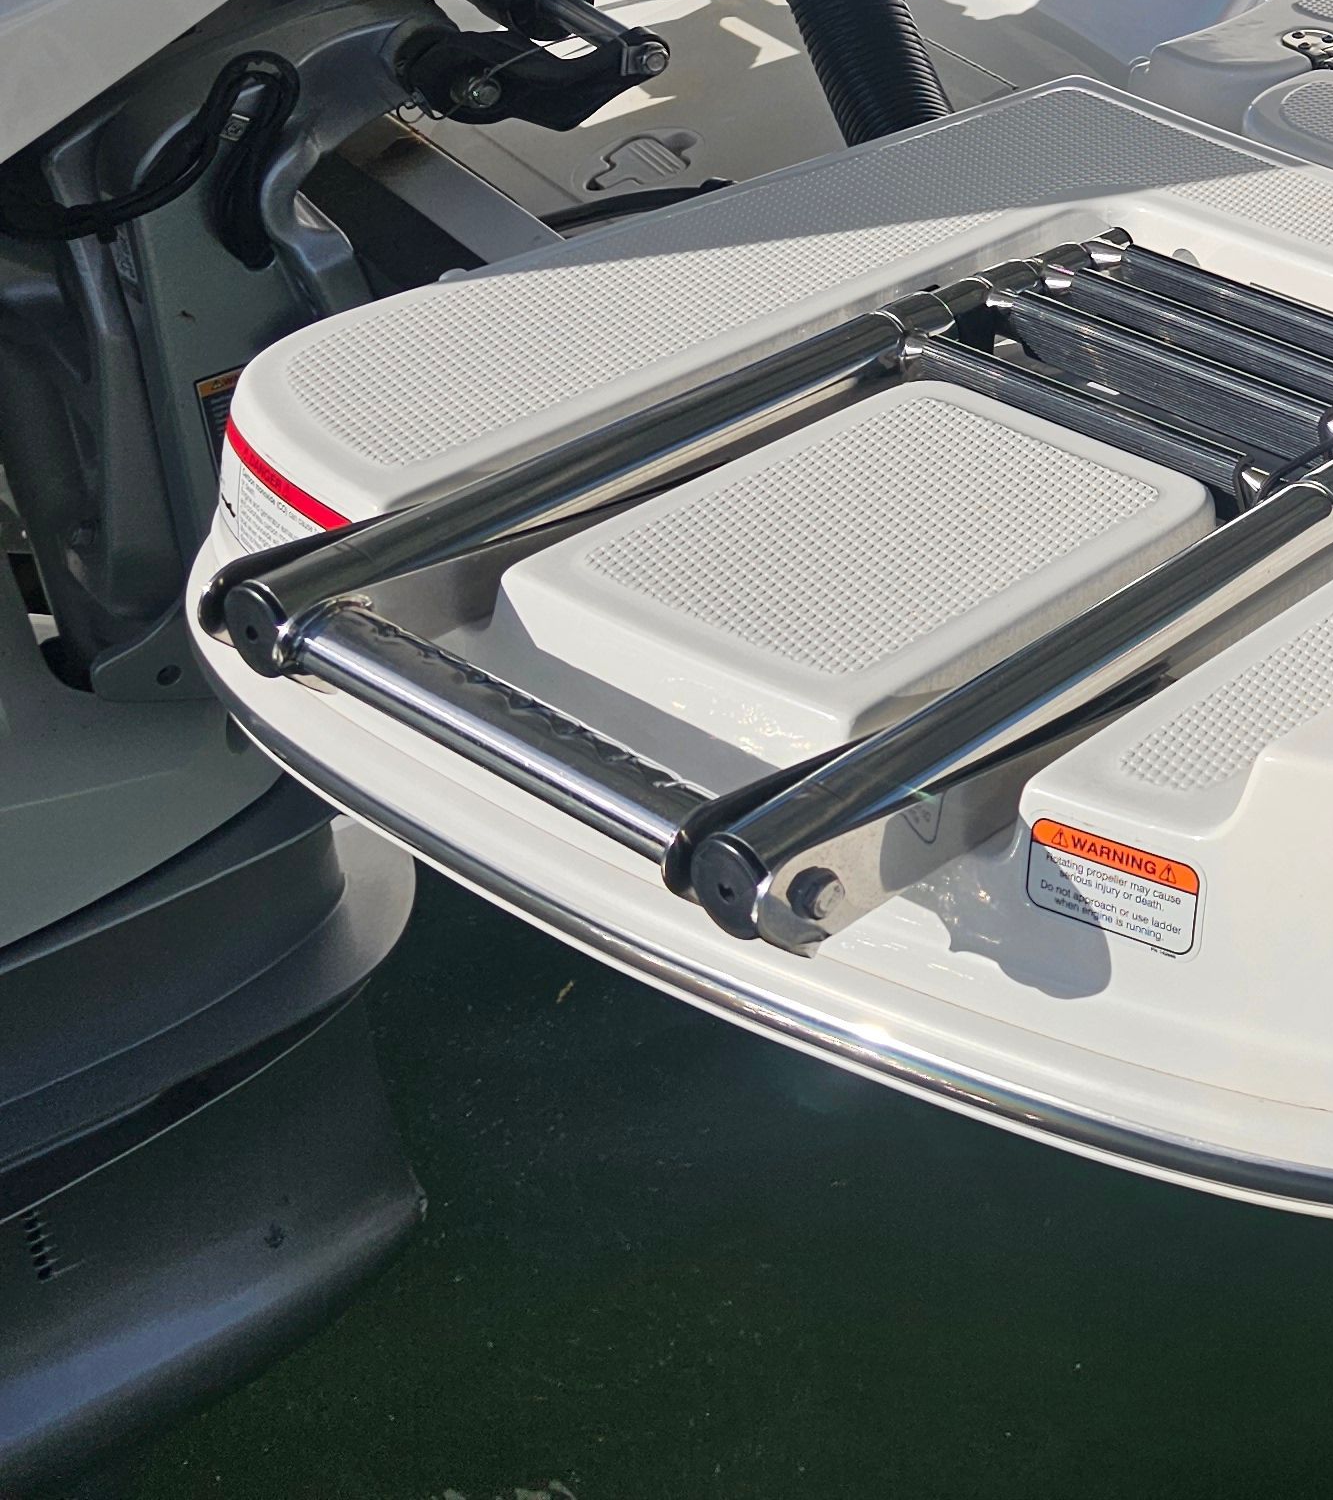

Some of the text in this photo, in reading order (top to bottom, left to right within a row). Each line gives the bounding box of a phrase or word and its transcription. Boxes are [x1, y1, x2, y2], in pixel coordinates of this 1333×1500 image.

[1071, 834, 1157, 876] WARNING
[1046, 852, 1182, 905] Rotating propeller may cause
[1060, 869, 1165, 912] serious injury or death.
[1040, 879, 1182, 936] Do not approach or use ladder
[1054, 897, 1164, 942] when engine is running.
